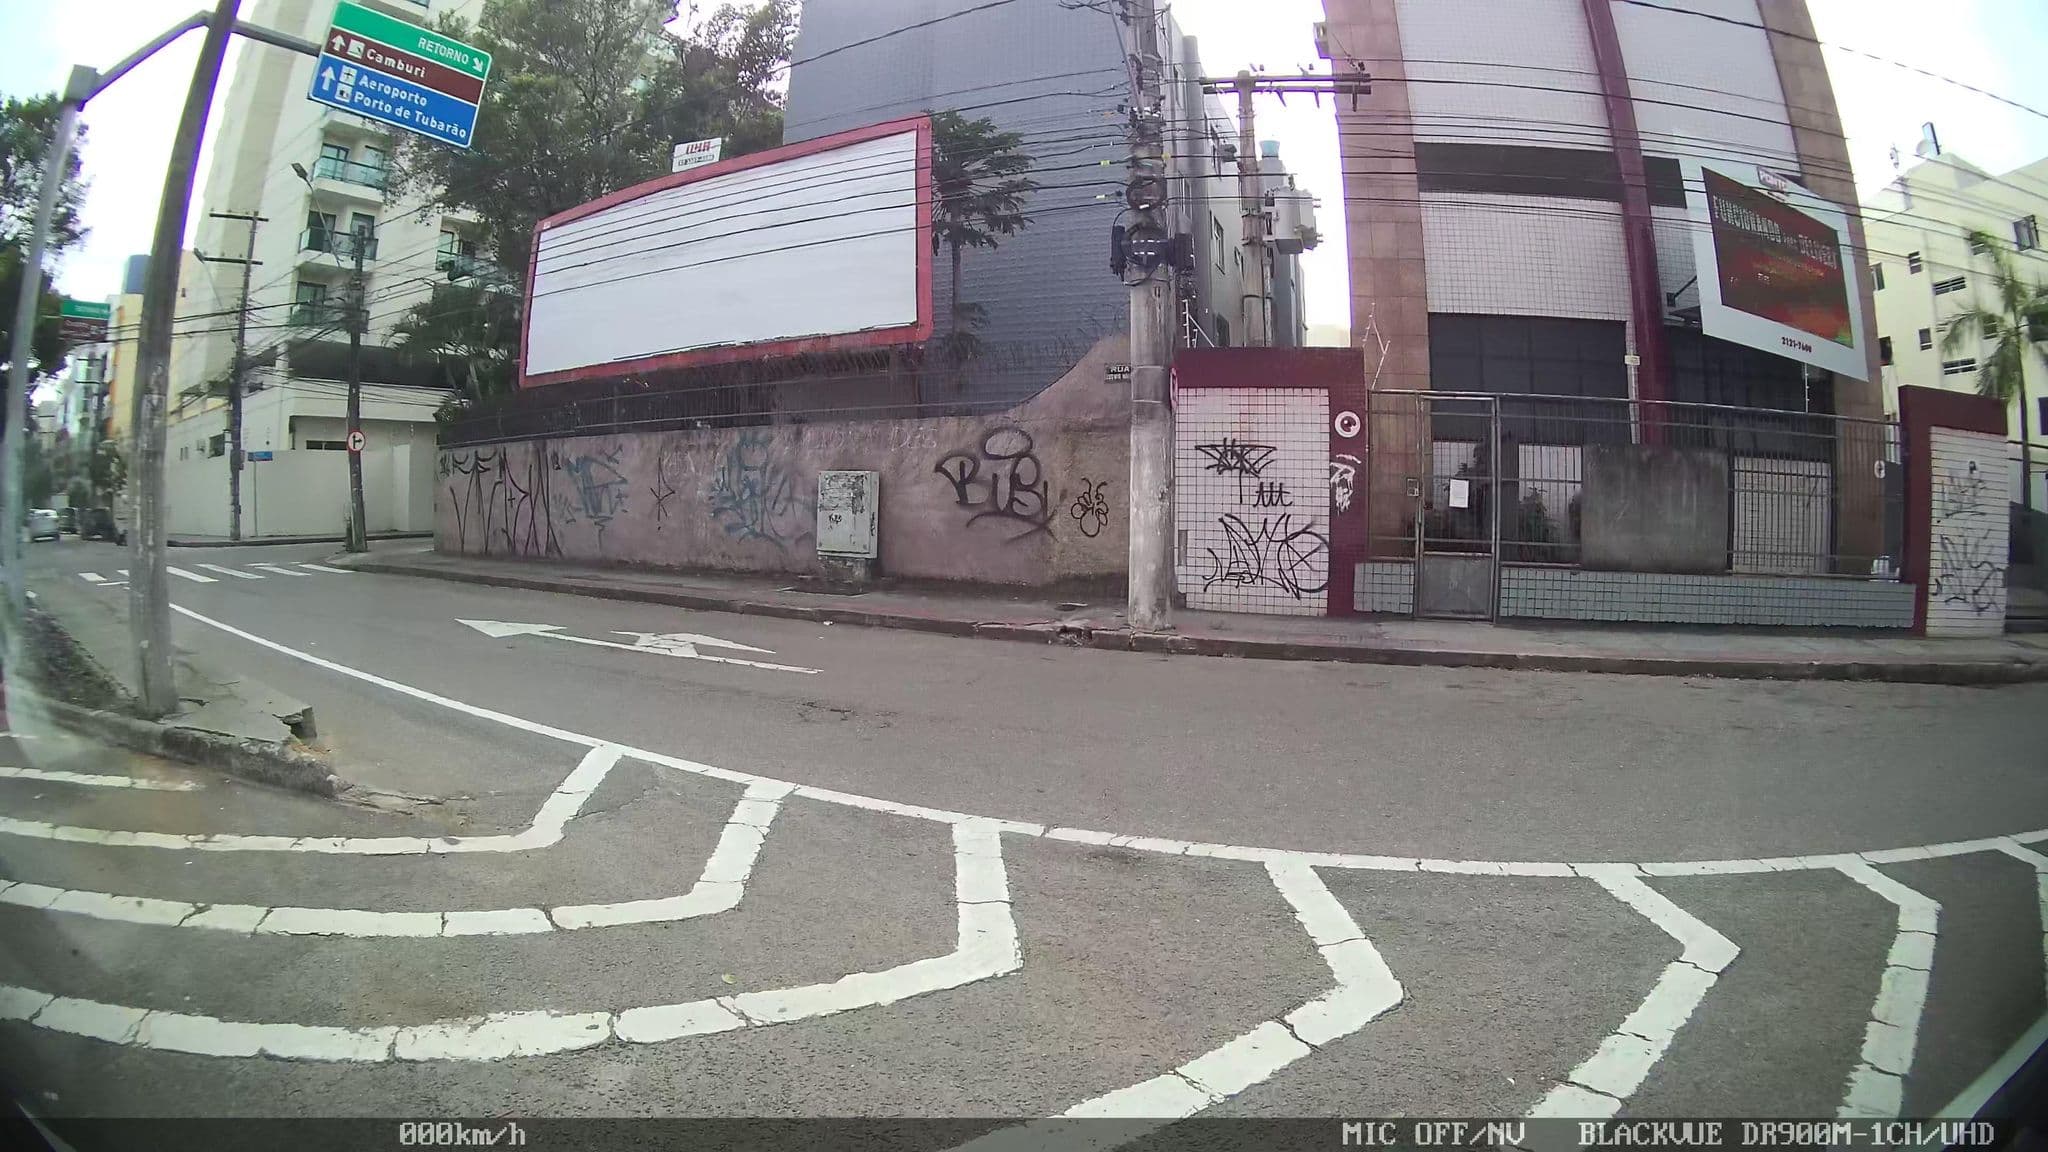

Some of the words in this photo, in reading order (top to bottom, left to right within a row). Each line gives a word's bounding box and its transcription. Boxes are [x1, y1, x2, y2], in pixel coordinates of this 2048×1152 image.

[366, 48, 427, 79] Camburi
[417, 36, 470, 66] RETORNO
[358, 74, 429, 108] Aeroporto
[354, 91, 393, 115] Porto
[394, 106, 412, 120] de
[414, 110, 467, 139] Tubarão
[1109, 365, 1131, 374] RUA
